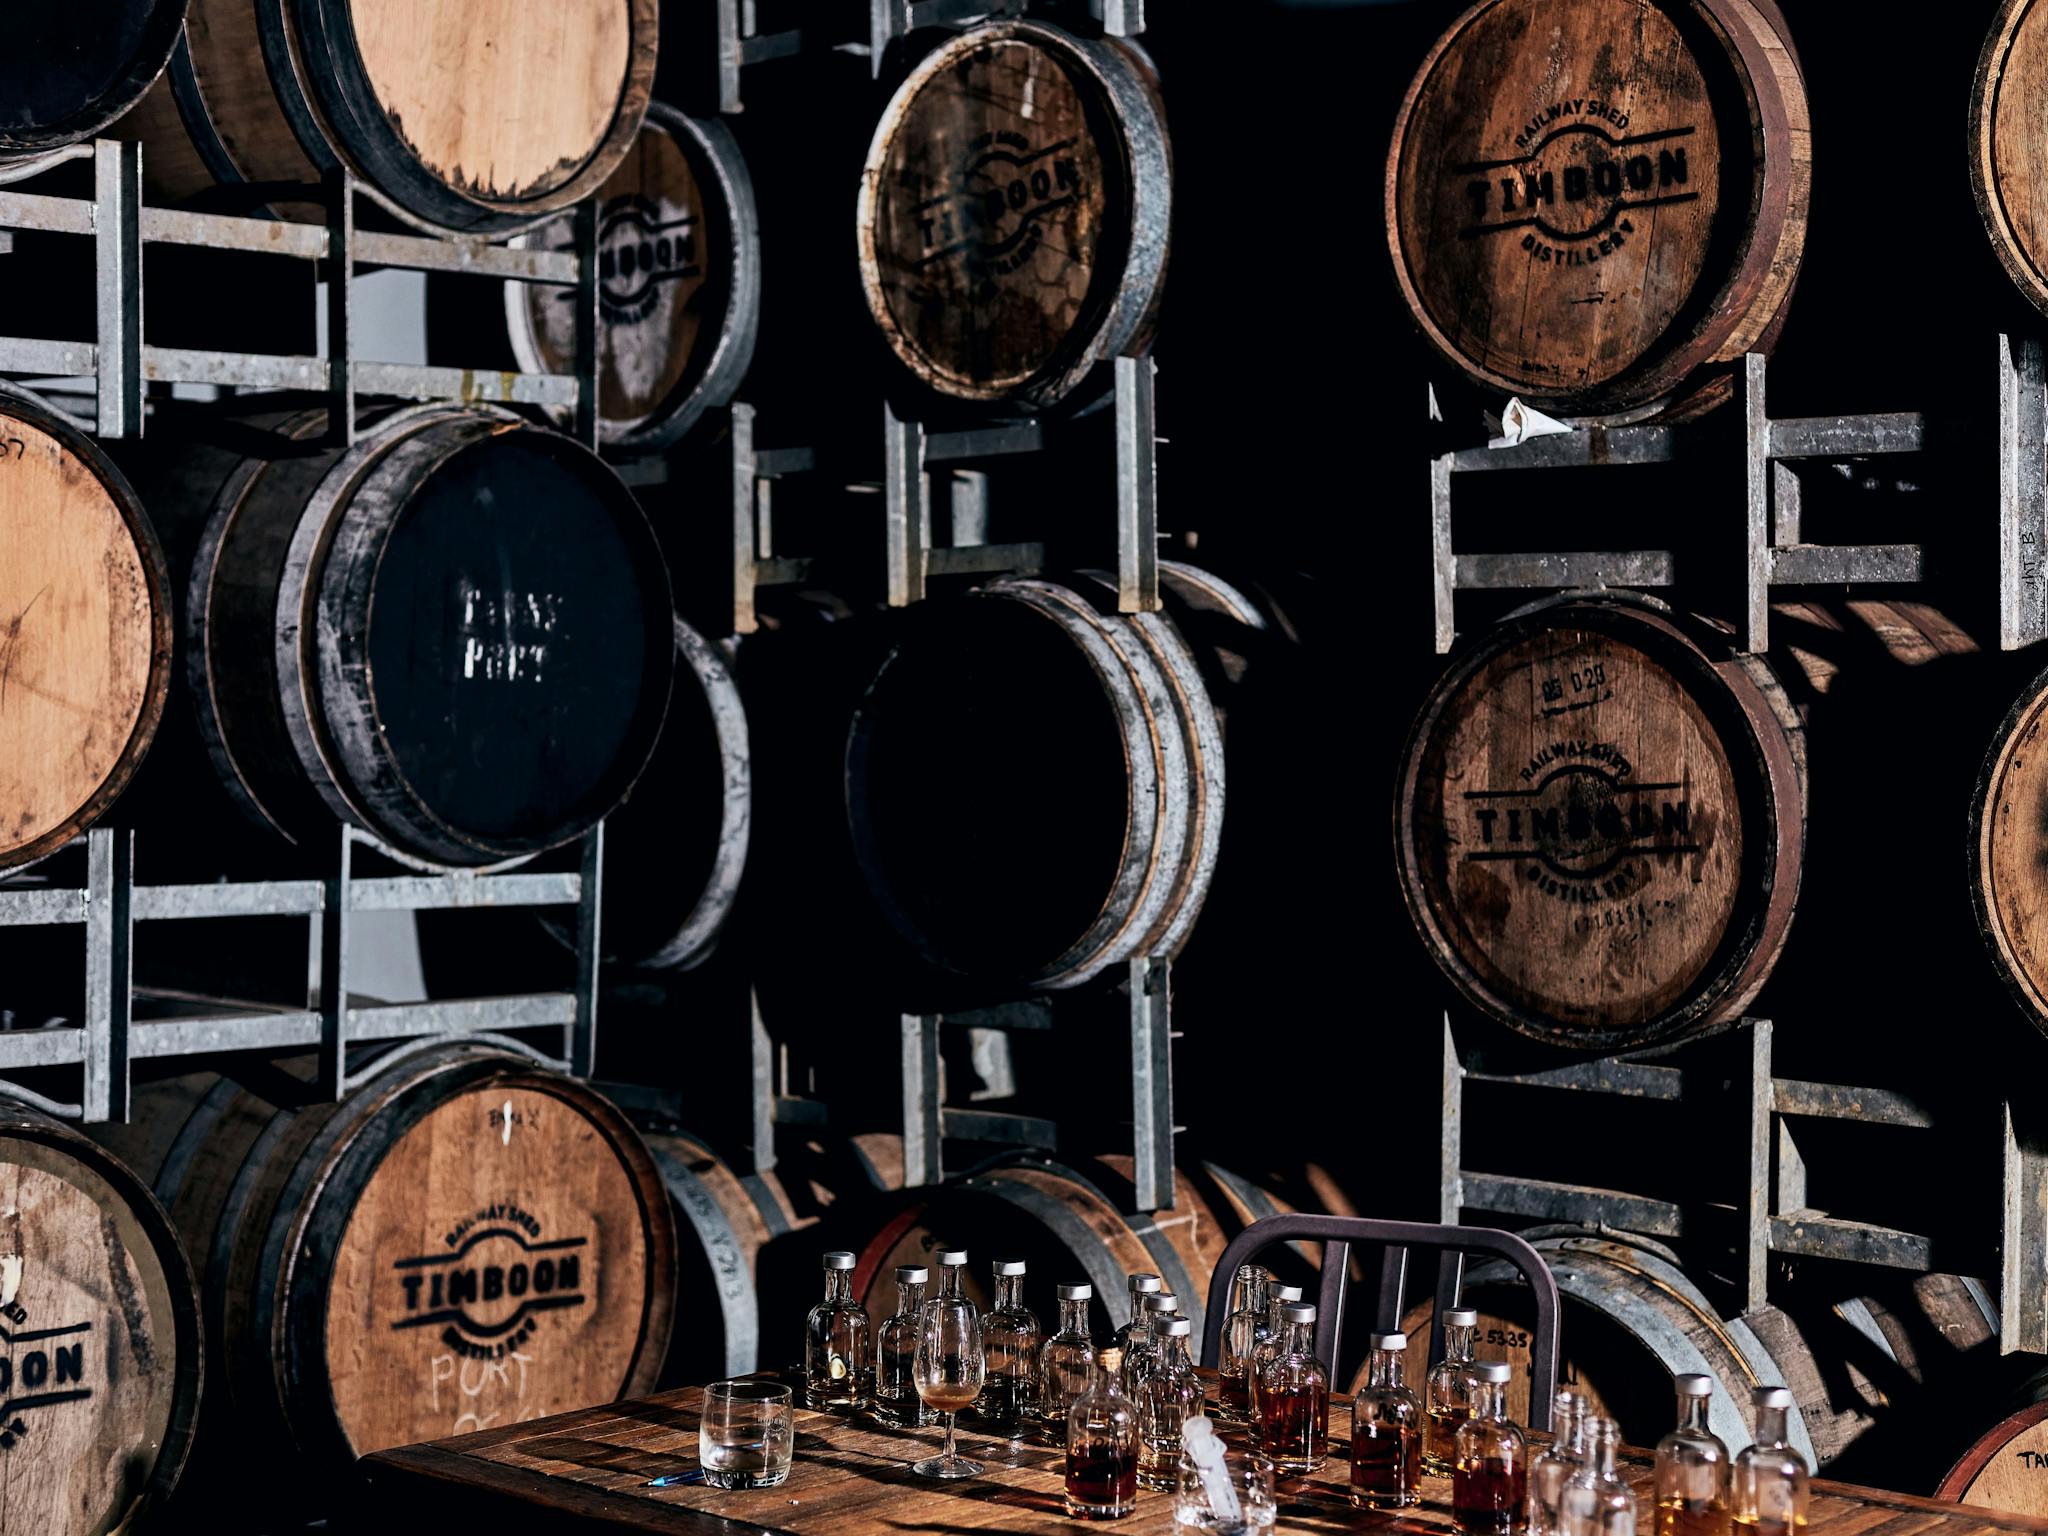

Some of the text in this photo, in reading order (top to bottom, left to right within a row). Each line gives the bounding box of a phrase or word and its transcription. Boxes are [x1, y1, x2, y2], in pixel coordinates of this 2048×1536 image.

[1515, 99, 1629, 149] RAILWAY SHED
[1466, 146, 1688, 219] TIMBOON
[1521, 219, 1634, 266] DISTILLERY
[1520, 740, 1587, 782] RAILWAY
[1476, 802, 1691, 844] TIMBOON
[1527, 862, 1636, 902] DISTILLERY
[402, 1256, 579, 1309] TIMBOON
[431, 1353, 533, 1413] PORT
